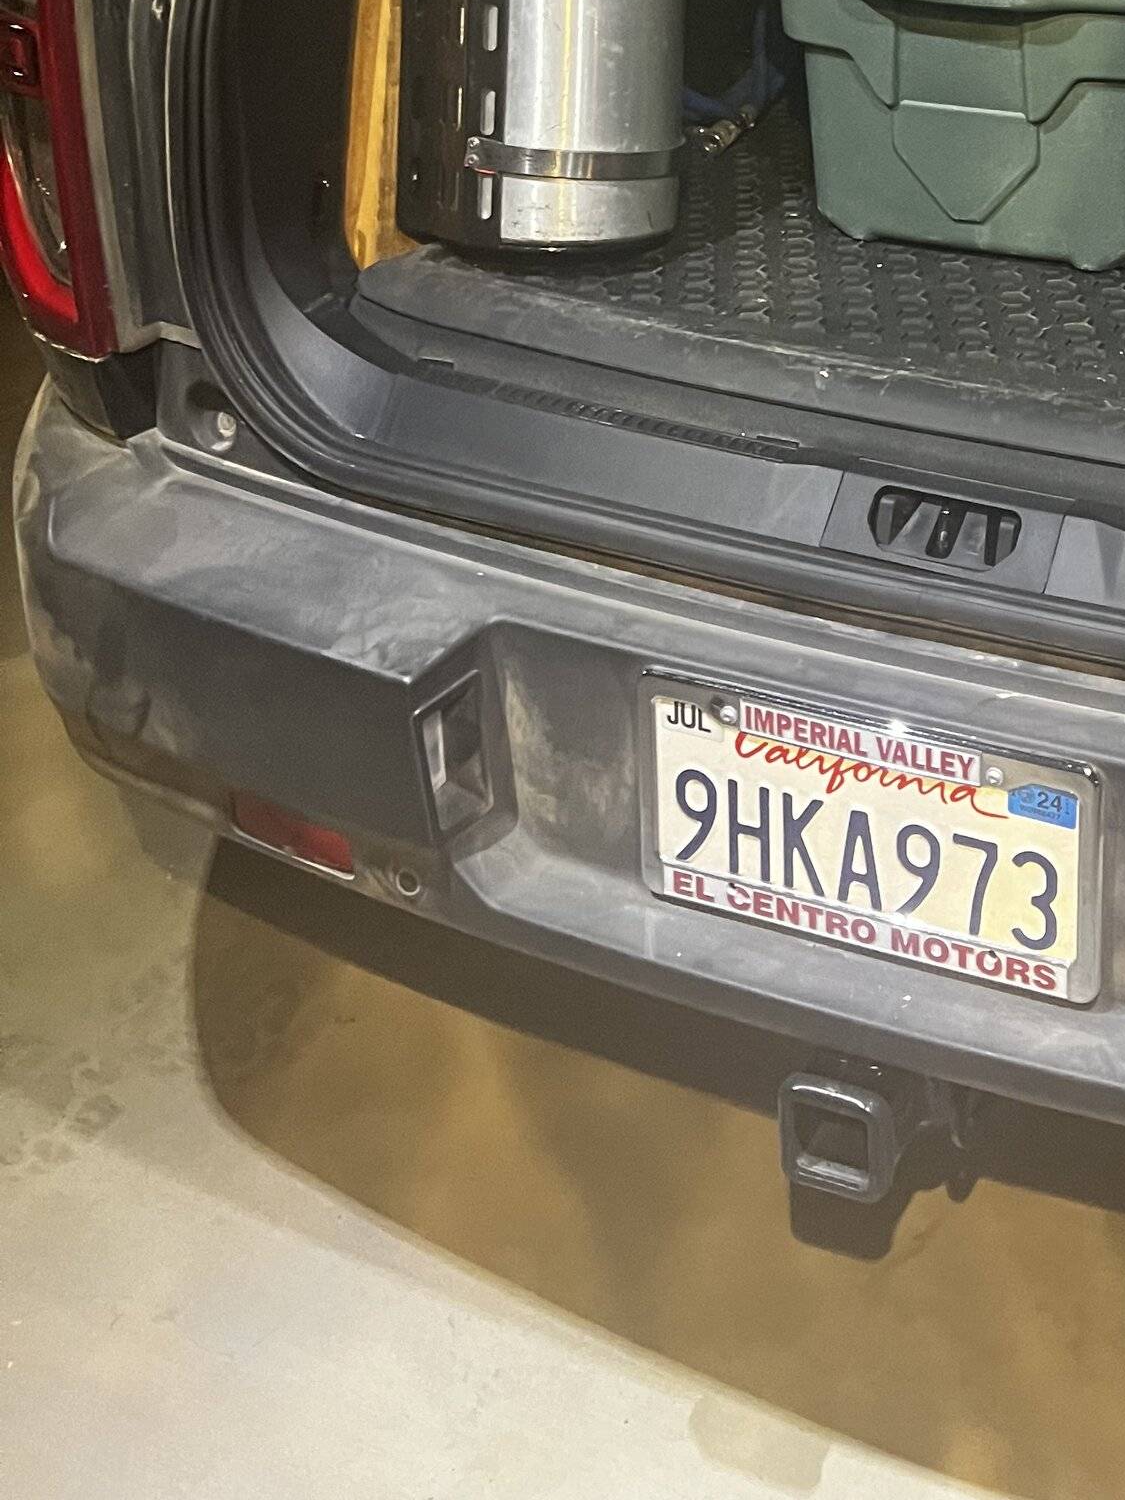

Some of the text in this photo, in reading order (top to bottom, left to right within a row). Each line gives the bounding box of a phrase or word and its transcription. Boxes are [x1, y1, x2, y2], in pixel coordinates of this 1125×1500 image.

[666, 700, 712, 733] JUL
[744, 705, 975, 781] IMPERIAL VALLEY
[1036, 790, 1063, 813] 24
[675, 768, 1058, 951] 9HKA973
[672, 870, 1057, 992] EL CENTRO MOTORS
